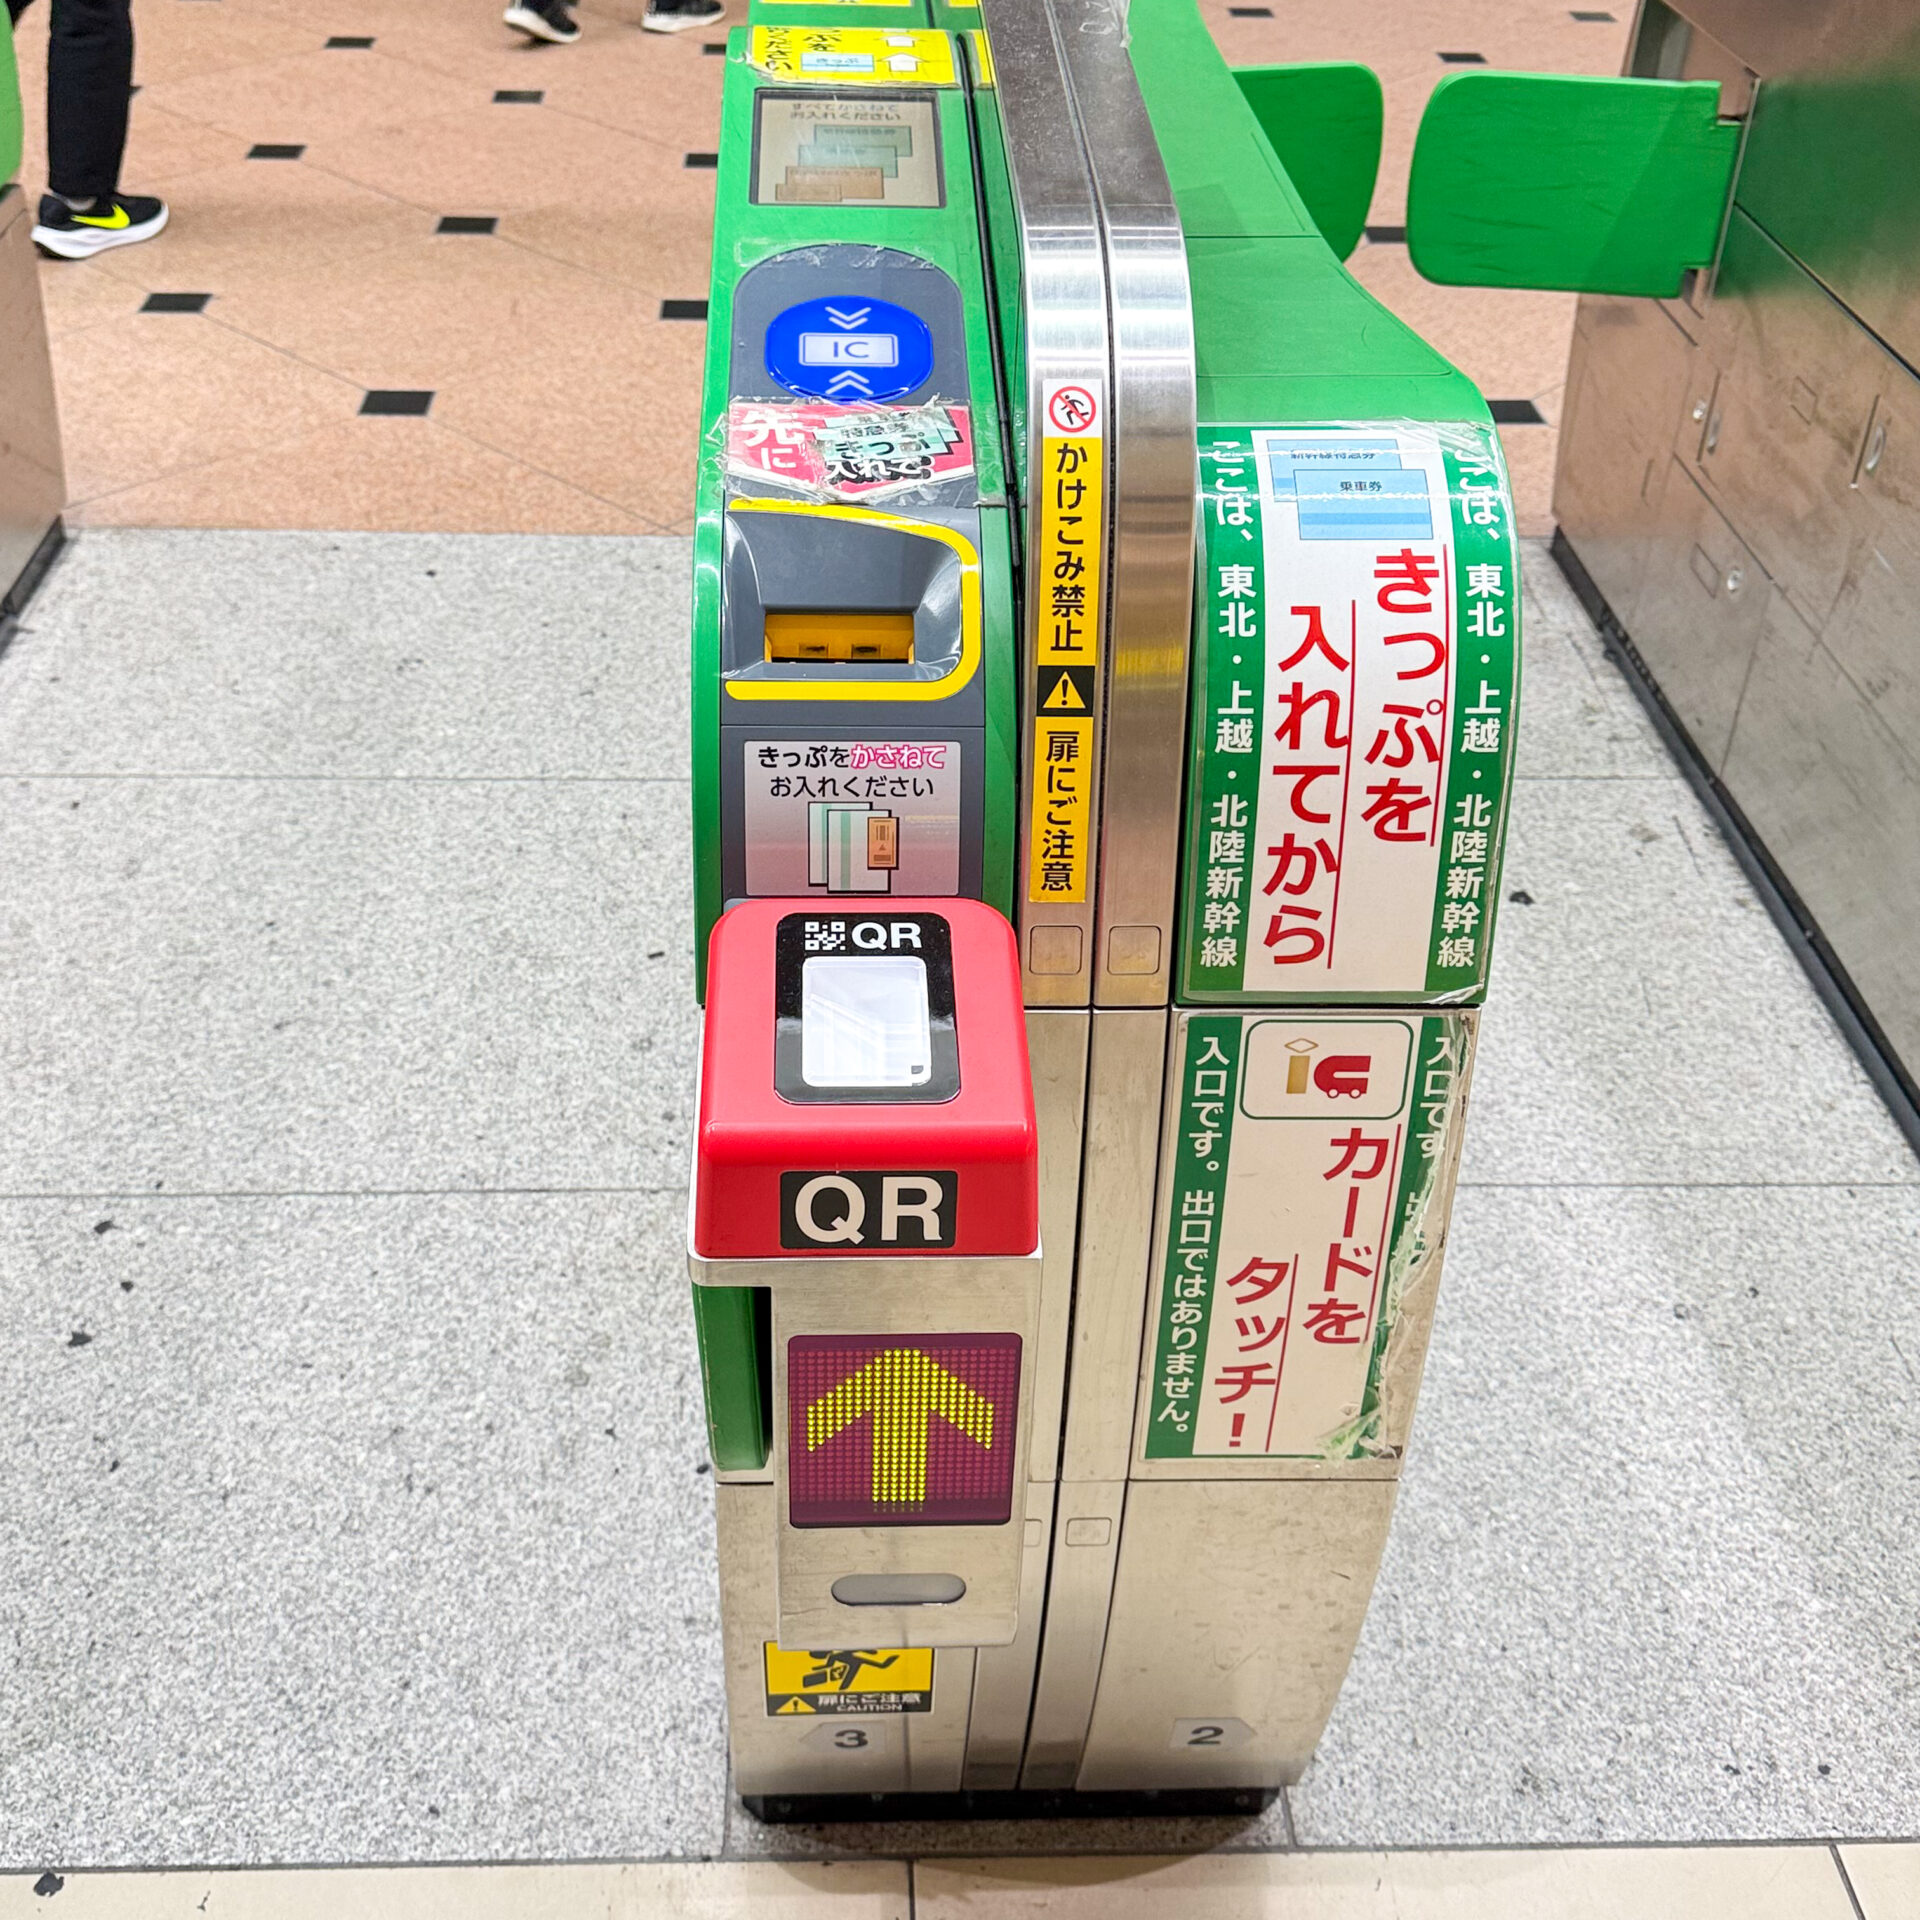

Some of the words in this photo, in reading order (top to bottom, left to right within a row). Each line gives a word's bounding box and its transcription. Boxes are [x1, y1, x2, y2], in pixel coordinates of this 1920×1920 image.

[833, 341, 869, 358] IC
[741, 410, 804, 470] 先に
[1339, 480, 1383, 493] 乗車券
[1050, 442, 1088, 652] かけこみ禁止
[1360, 547, 1447, 842] きっぷを
[758, 744, 946, 769] きっぷをかさねて
[770, 775, 934, 798] お入れください
[1262, 605, 1350, 965] 入れてから
[1040, 730, 1079, 893] 扉にご注意
[851, 921, 922, 951] QR
[794, 1174, 944, 1246] QR
[1157, 1036, 1231, 1433] 入口です。出口ではありません。
[1302, 1127, 1390, 1344] カードを
[817, 1692, 922, 1706] 扉にご注意
[836, 1703, 903, 1712] CAUTION
[833, 1729, 869, 1749] 3
[1187, 1725, 1225, 1746] 2
